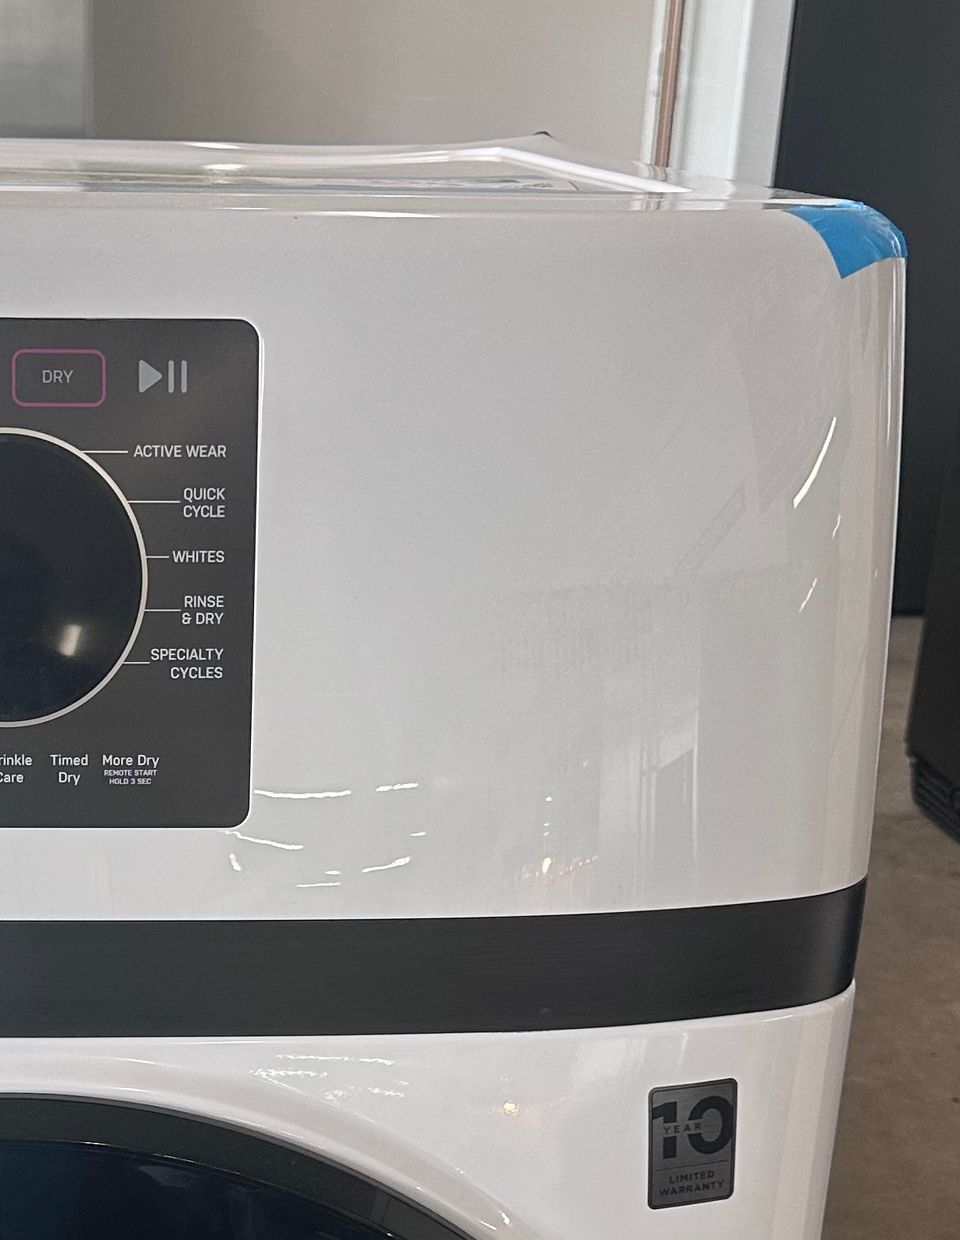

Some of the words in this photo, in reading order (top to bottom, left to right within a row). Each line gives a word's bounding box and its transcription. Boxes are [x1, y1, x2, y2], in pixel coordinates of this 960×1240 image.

[42, 370, 74, 384] DRY
[133, 445, 182, 458] ACTIVE
[186, 445, 227, 458] WEAR
[183, 487, 226, 503] QUICK
[183, 505, 226, 518] CYCLE
[172, 550, 225, 563] WHITES
[184, 595, 225, 608] RINSE
[181, 612, 192, 625] &
[195, 612, 224, 625] DRY
[150, 648, 224, 661] SPECIALTY
[170, 666, 223, 679] CYCLES
[50, 754, 89, 766] Timed
[102, 754, 134, 766] More
[137, 754, 160, 769] Dry
[58, 771, 80, 786] Dry
[103, 769, 132, 777] REMOTE
[134, 769, 158, 777] START
[651, 1095, 734, 1159] 10
[663, 1122, 702, 1135] YEAR
[669, 1170, 715, 1184] LIMITED
[659, 1180, 724, 1197] WARRANTY
